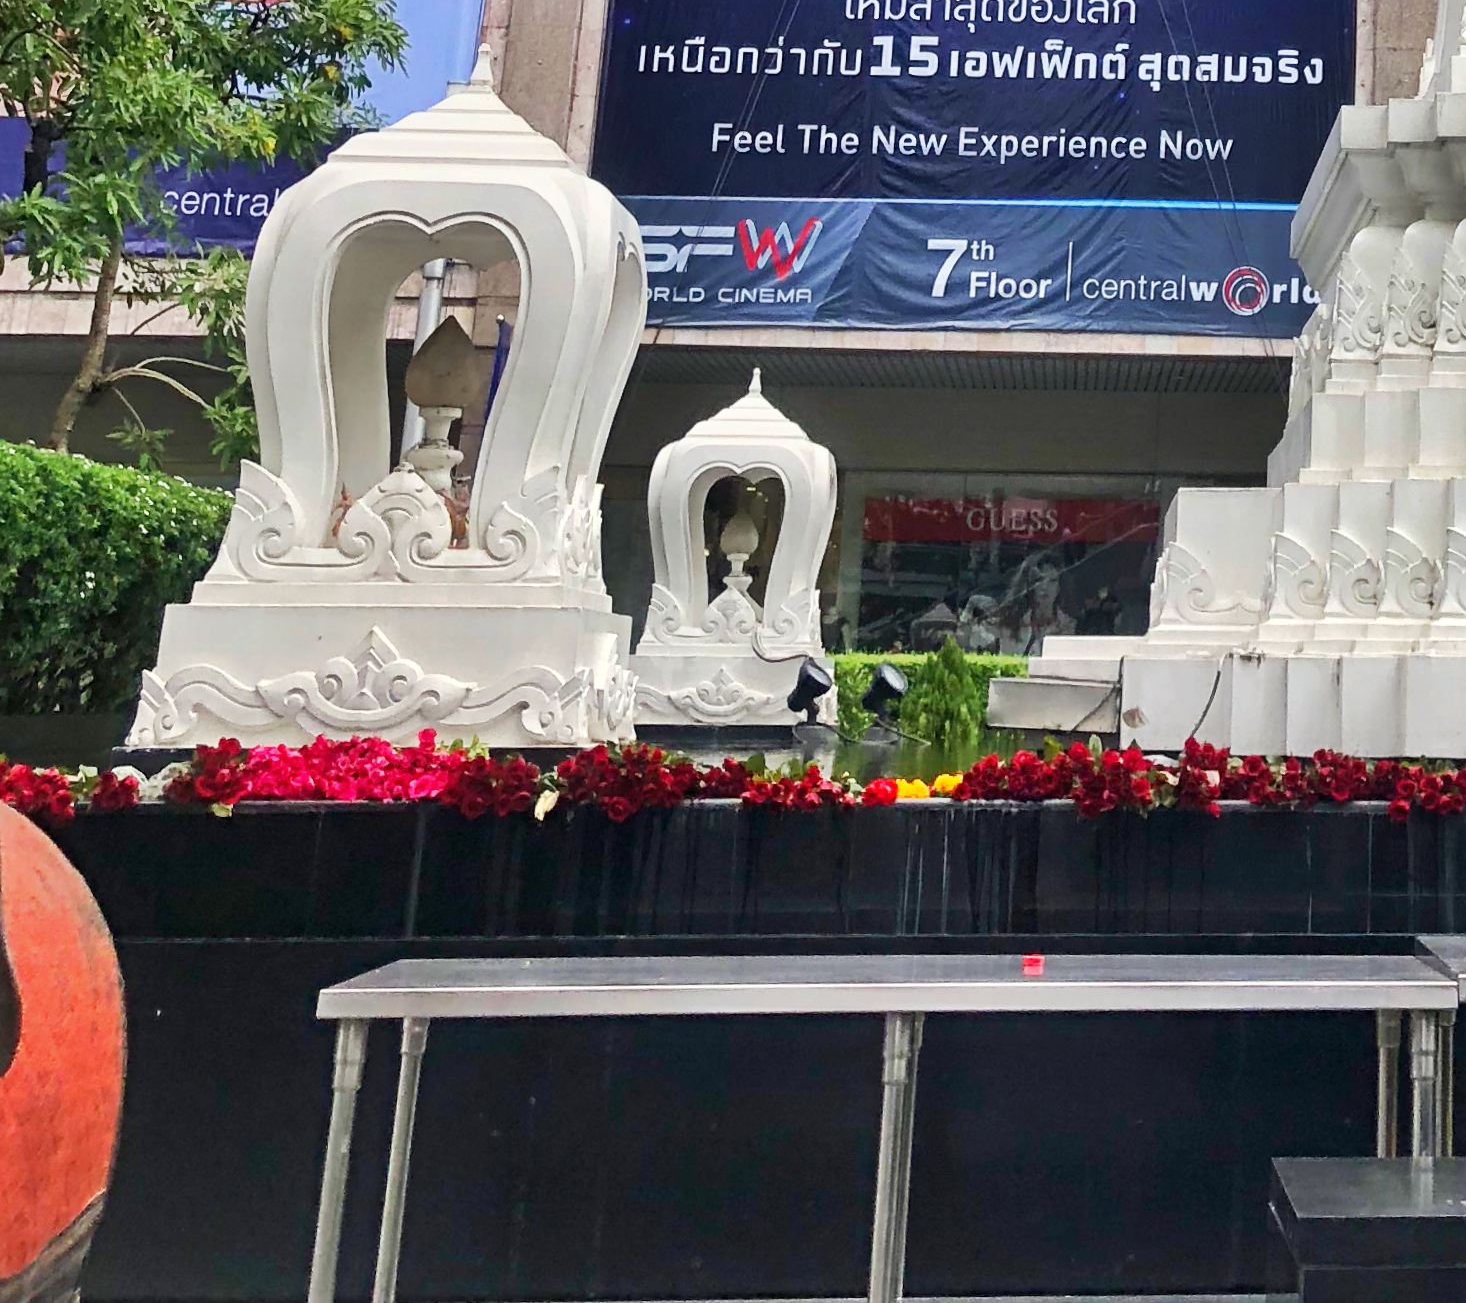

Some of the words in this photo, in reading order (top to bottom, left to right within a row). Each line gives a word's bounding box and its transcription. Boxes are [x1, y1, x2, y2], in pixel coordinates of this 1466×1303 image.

[638, 36, 862, 77] เหนือกว่ากับ
[869, 35, 939, 77] 15
[949, 39, 1130, 80] เอฟเฟ็กต์
[1138, 49, 1324, 91] สุดสมจริง
[711, 122, 787, 155] Feel
[798, 124, 860, 156] The
[871, 126, 948, 157] New
[958, 127, 1148, 164] Experience
[1159, 130, 1233, 160] Now
[647, 286, 705, 304] RLD
[717, 286, 812, 304] CINEMA
[969, 271, 1052, 299] Floor
[966, 508, 1058, 532] GUESS
